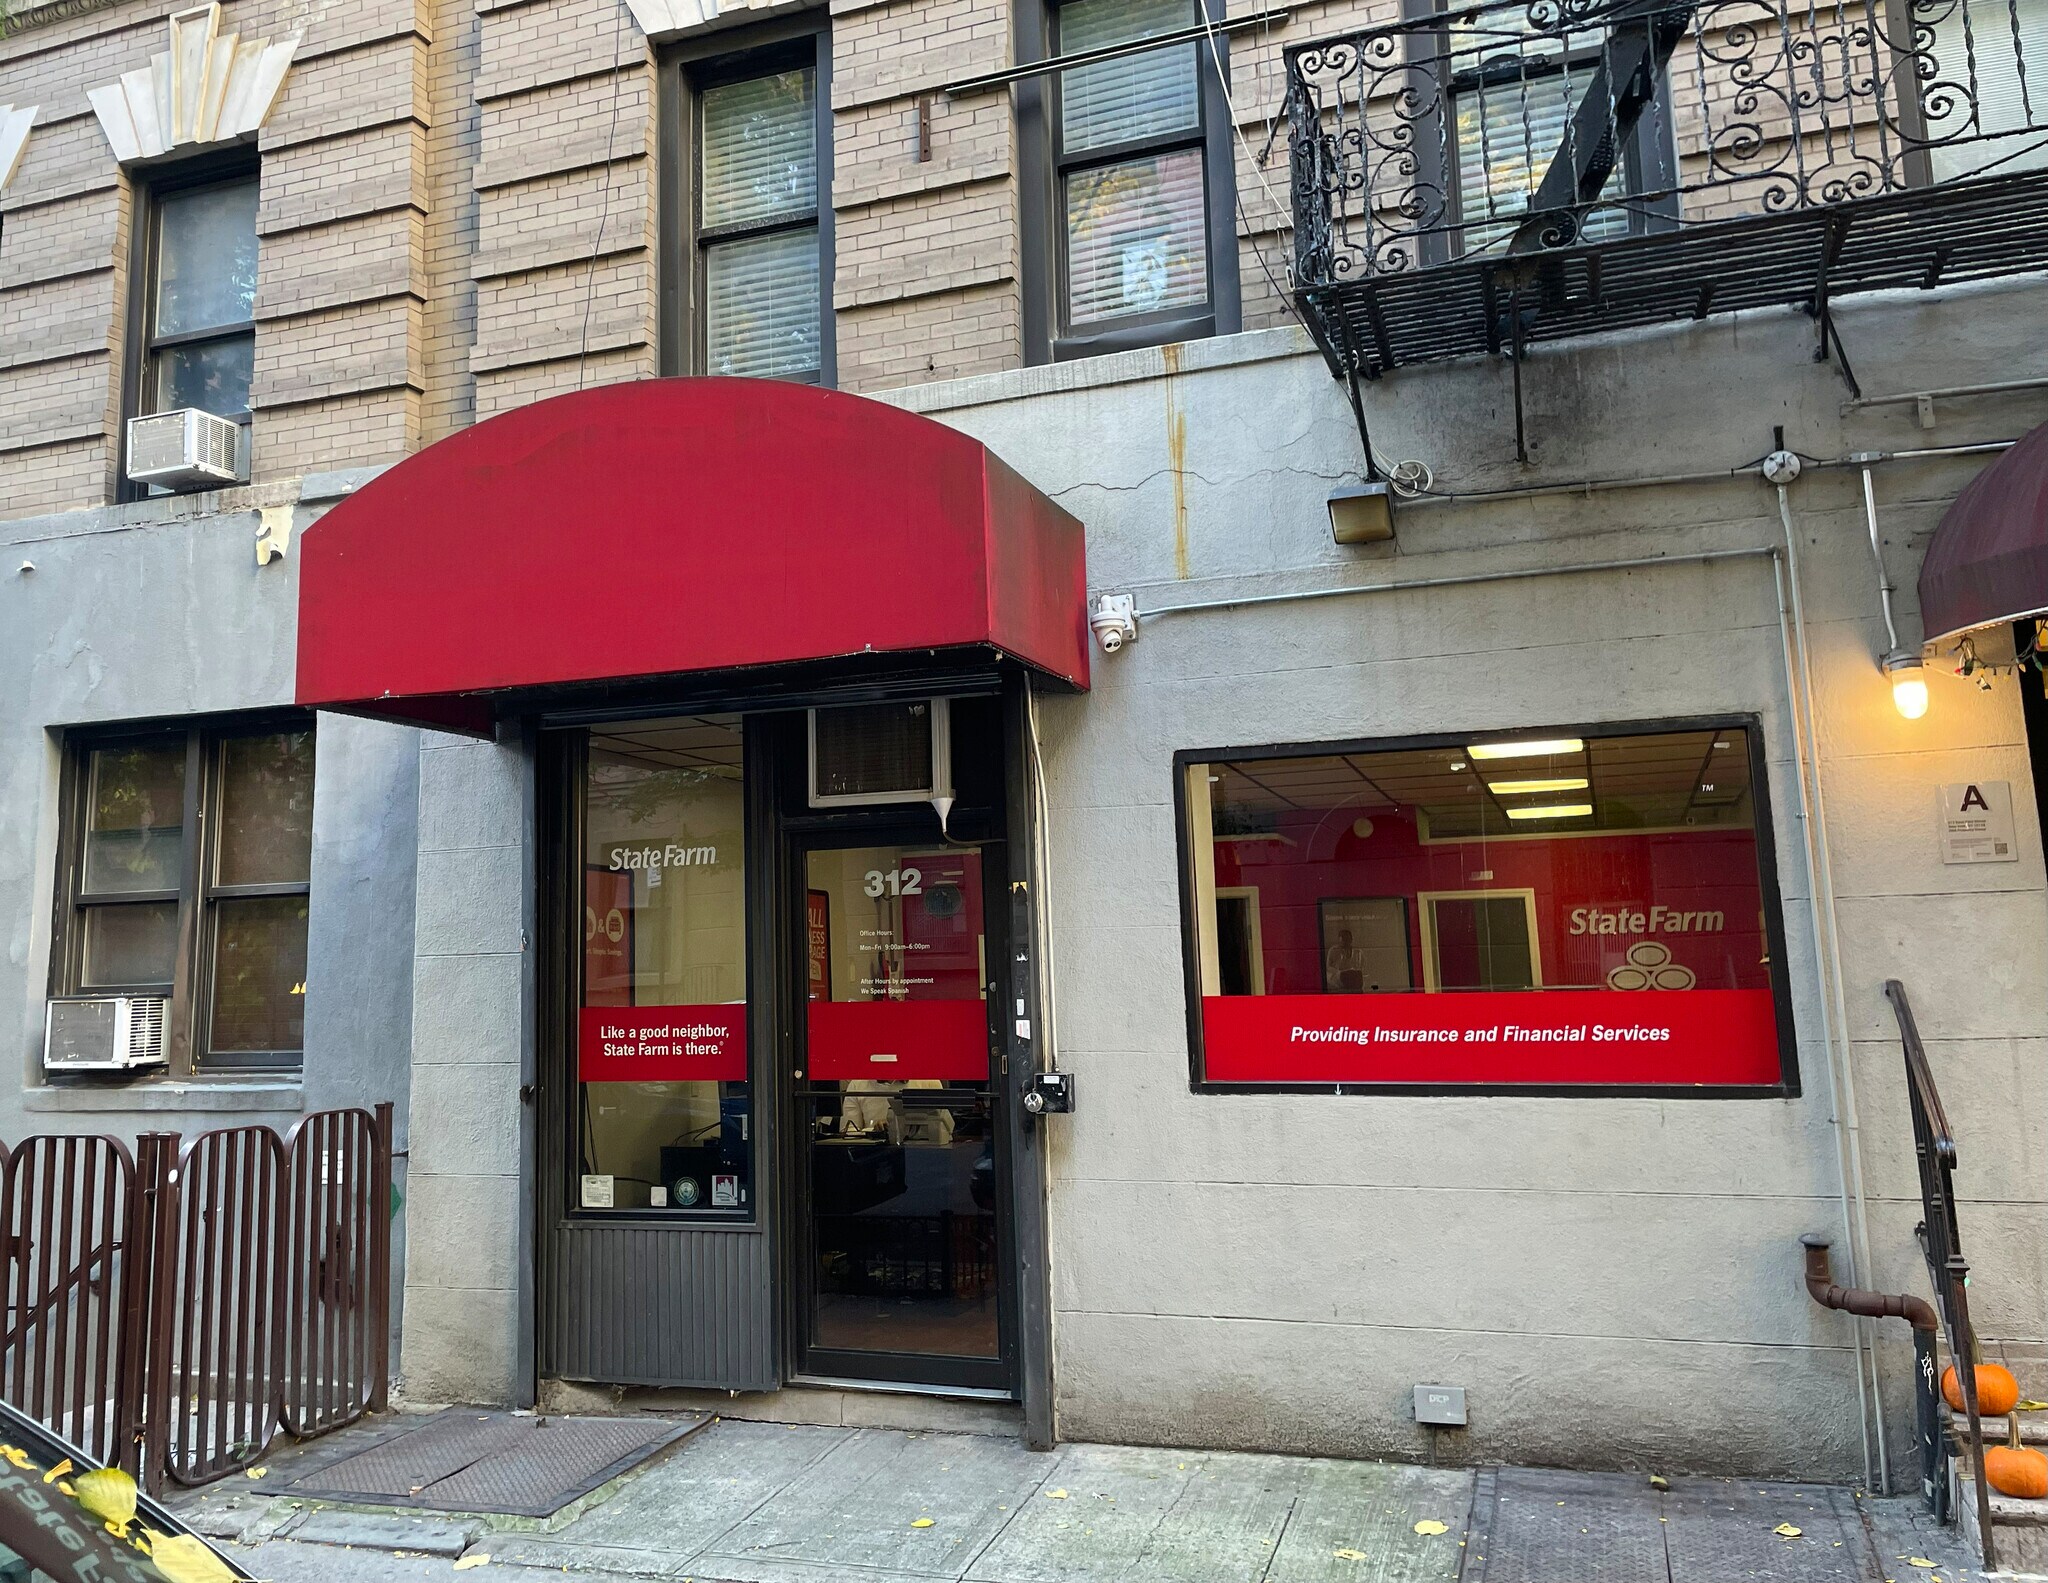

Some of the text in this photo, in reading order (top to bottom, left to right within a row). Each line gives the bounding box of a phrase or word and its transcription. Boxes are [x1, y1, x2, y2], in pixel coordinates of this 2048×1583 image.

[1960, 785, 1989, 812] A
[863, 867, 922, 898] 312
[892, 978, 899, 986] by
[899, 977, 934, 985] appointment
[870, 987, 887, 995] Speak
[888, 987, 910, 995] Spanish
[600, 1023, 730, 1041] Like a good neighbor,
[1290, 1024, 1671, 1046] Providing Insurance and Financial Services
[603, 1043, 635, 1056] State
[638, 1042, 669, 1055] Farm
[672, 1042, 682, 1055] is
